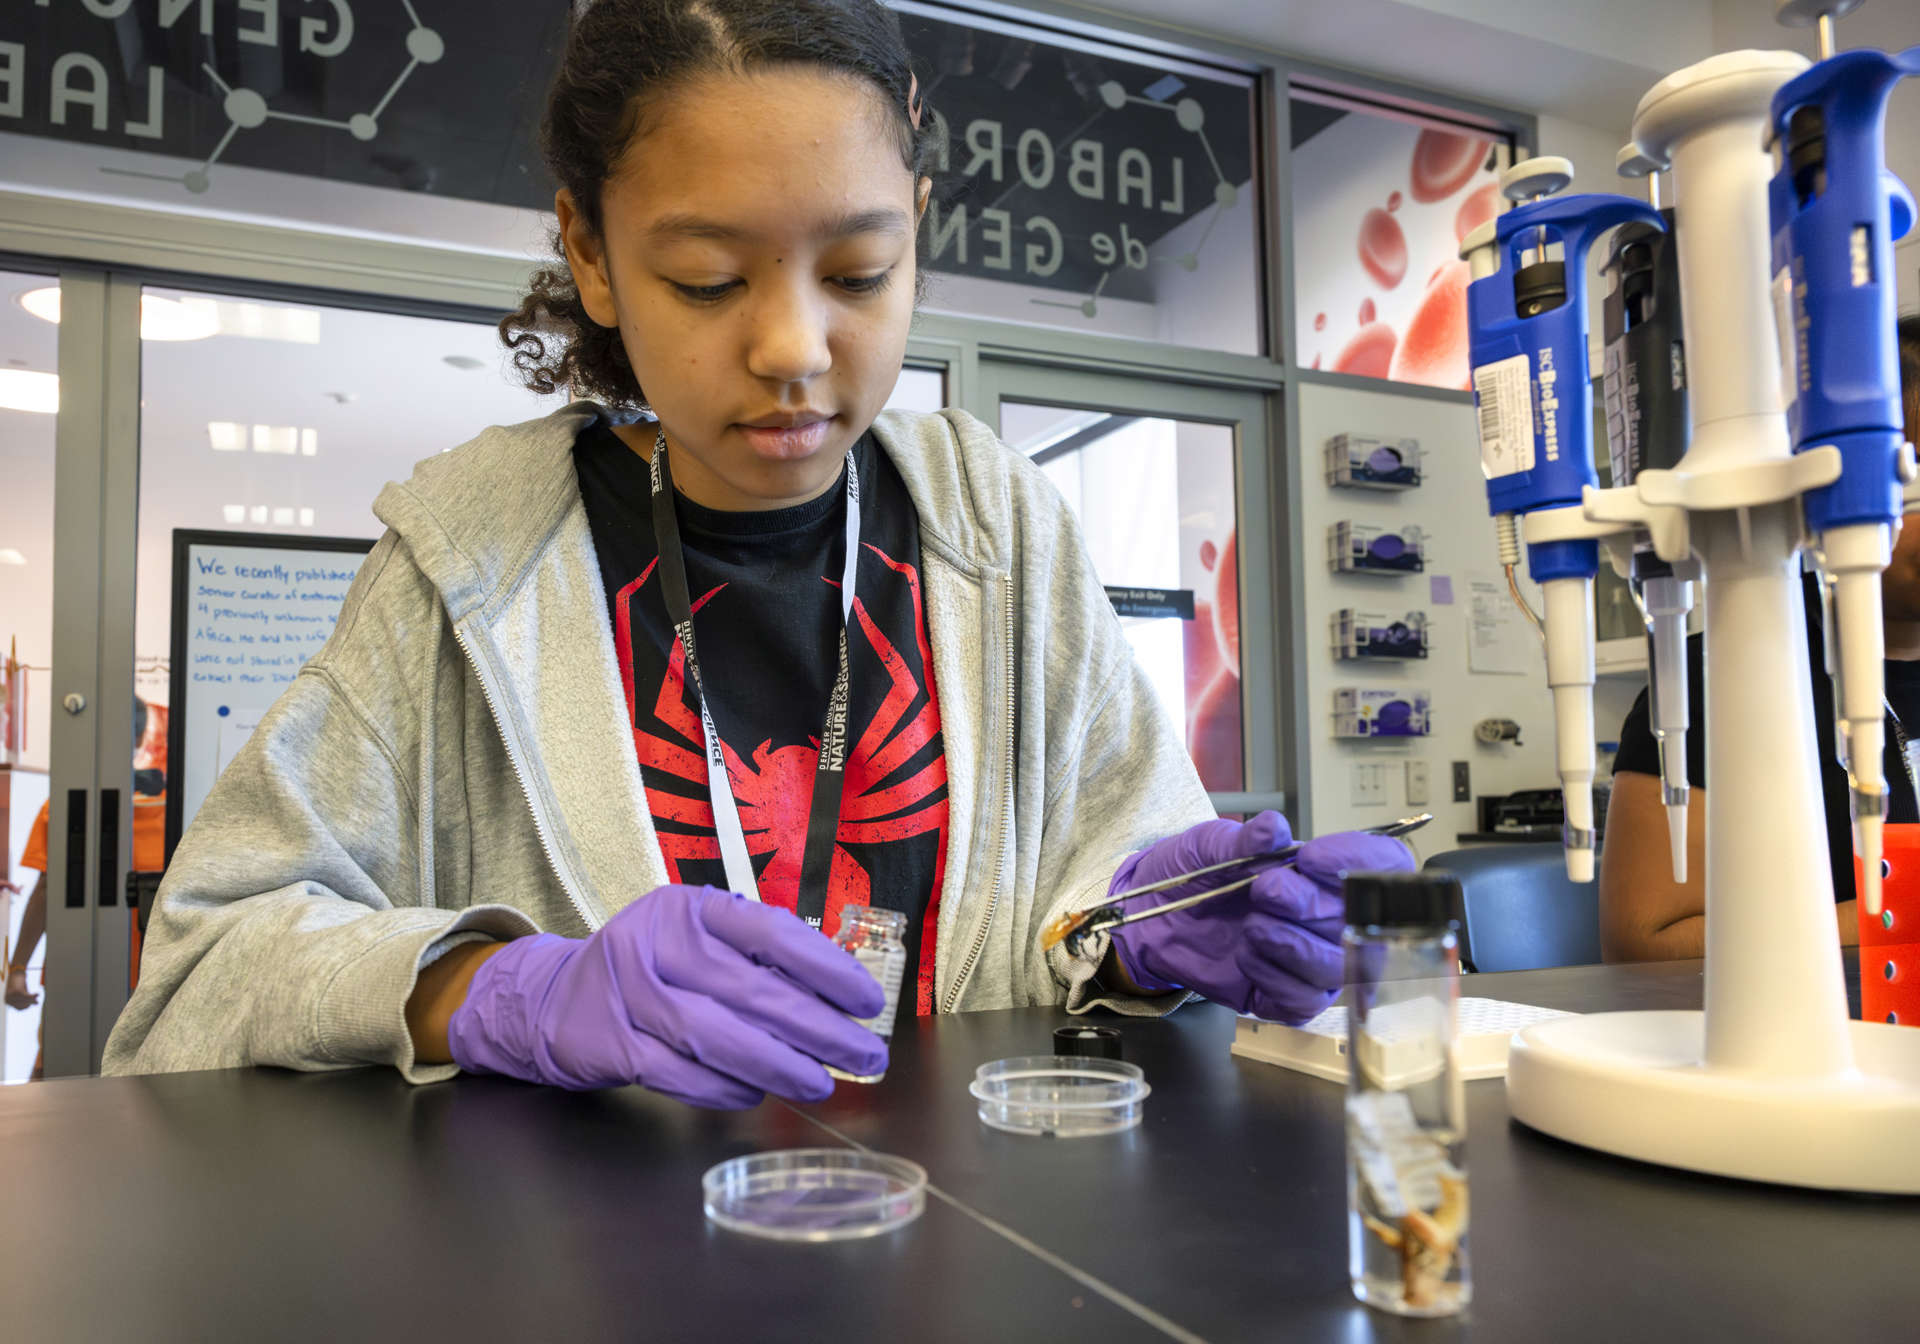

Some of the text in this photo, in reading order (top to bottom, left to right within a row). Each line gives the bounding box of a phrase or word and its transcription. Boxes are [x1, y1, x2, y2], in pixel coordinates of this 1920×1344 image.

[196, 557, 355, 585] We recently published
[818, 730, 831, 771] DENVER
